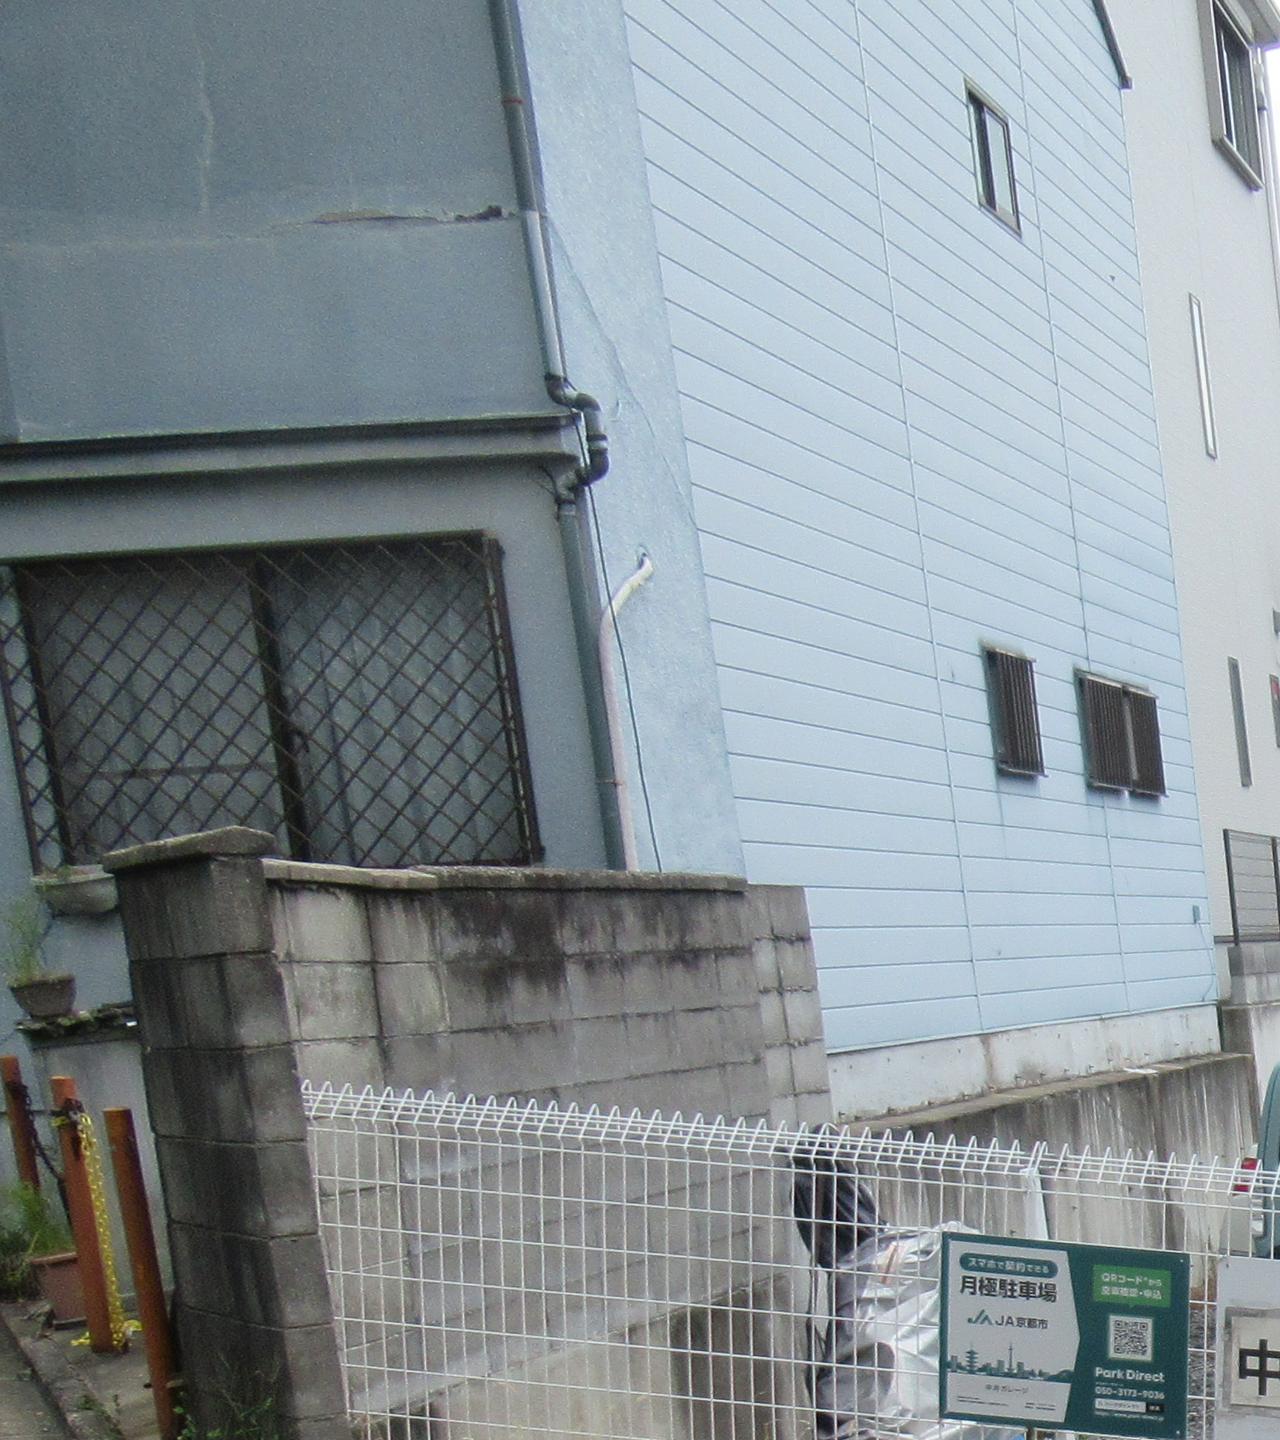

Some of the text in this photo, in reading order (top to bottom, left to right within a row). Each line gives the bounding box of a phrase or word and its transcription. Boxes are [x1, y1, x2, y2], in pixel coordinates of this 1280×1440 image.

[960, 1275, 1058, 1303] 月極駐車場
[1095, 1366, 1165, 1383] Park Direct
